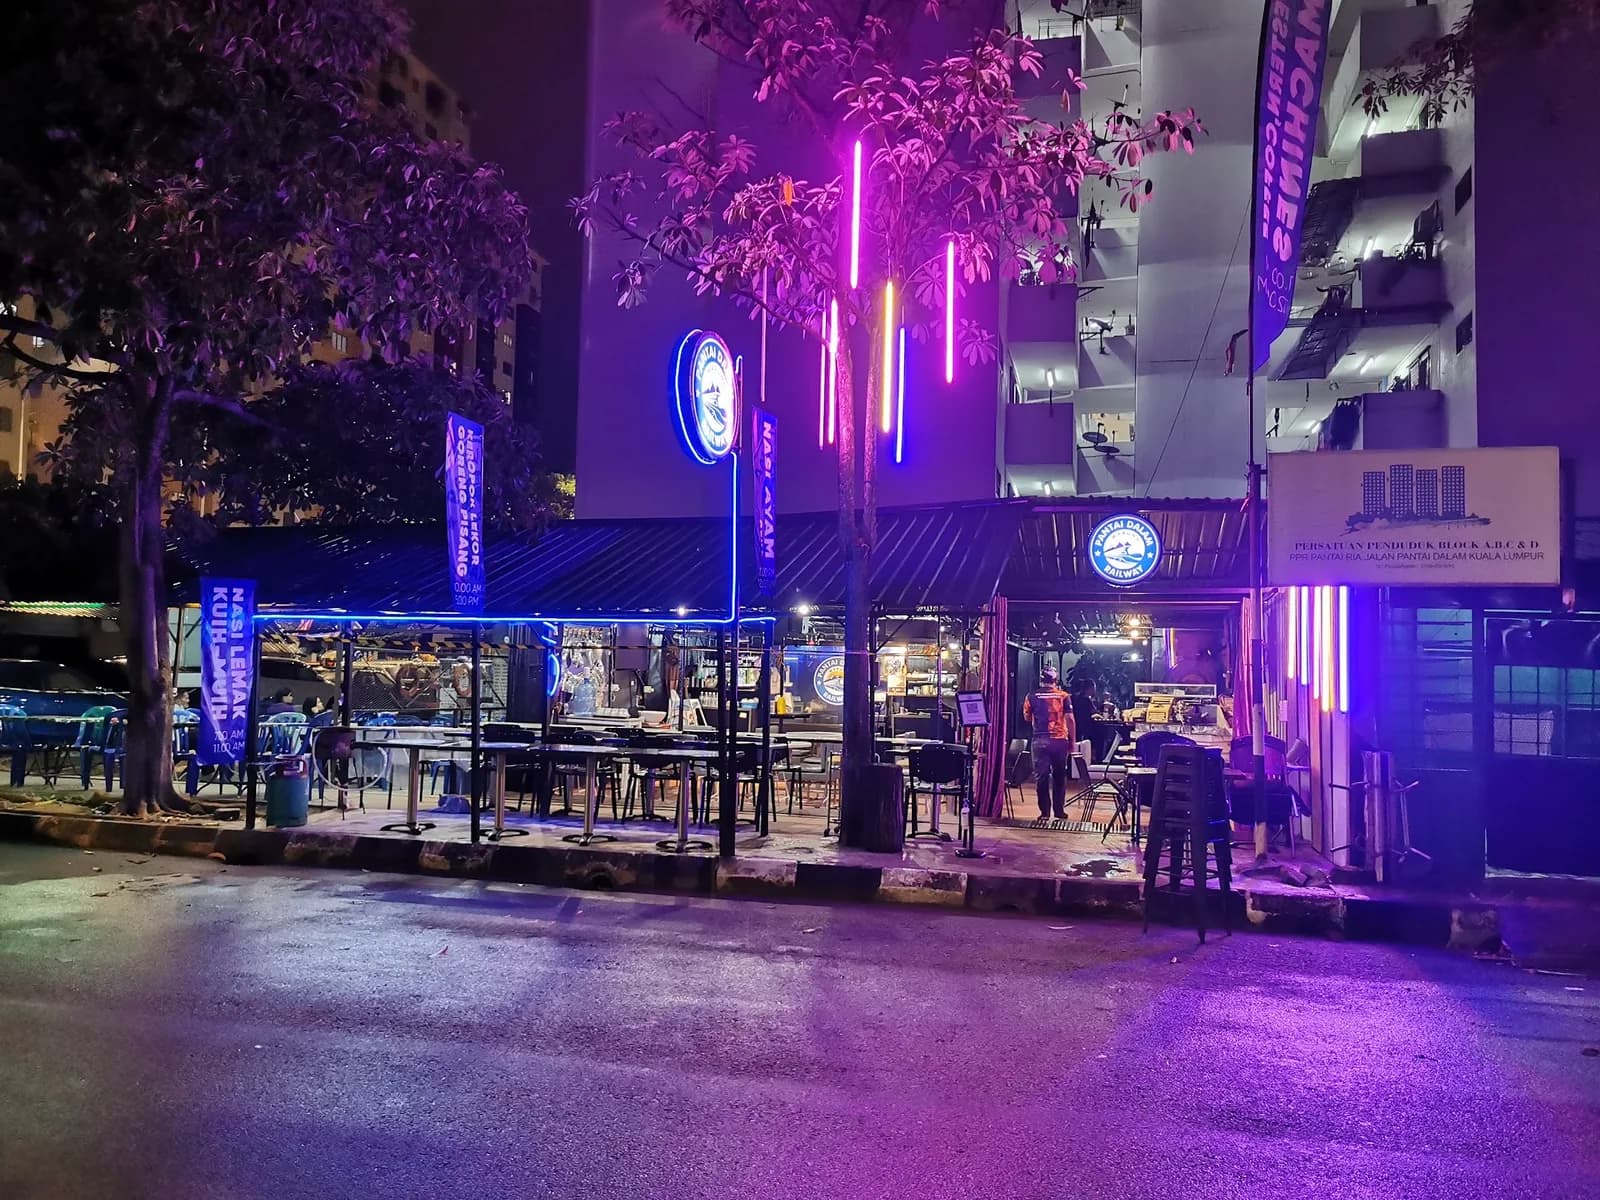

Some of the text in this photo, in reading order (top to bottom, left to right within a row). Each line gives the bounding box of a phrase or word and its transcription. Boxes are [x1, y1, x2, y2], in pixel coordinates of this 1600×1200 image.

[763, 421, 772, 478] NASI
[456, 425, 469, 577] GORENG PISANG
[467, 428, 480, 566] KEROPOK LEKOR
[764, 486, 775, 558] AYAM
[1094, 520, 1124, 546] PANTAI
[1126, 520, 1154, 546] DALAM
[1295, 542, 1363, 550] PERSATUAN
[1366, 541, 1434, 550] PENDUDUK
[1396, 552, 1431, 560] PANTAI
[1432, 552, 1467, 560] DALAM
[1469, 552, 1501, 560] KUALA
[1503, 552, 1545, 560] LUMPUR
[1103, 564, 1144, 578] RAILWAY
[230, 587, 246, 720] NASI LEMAK
[822, 691, 844, 702] RAILW
[231, 729, 244, 739] AM
[232, 741, 245, 751] AM
